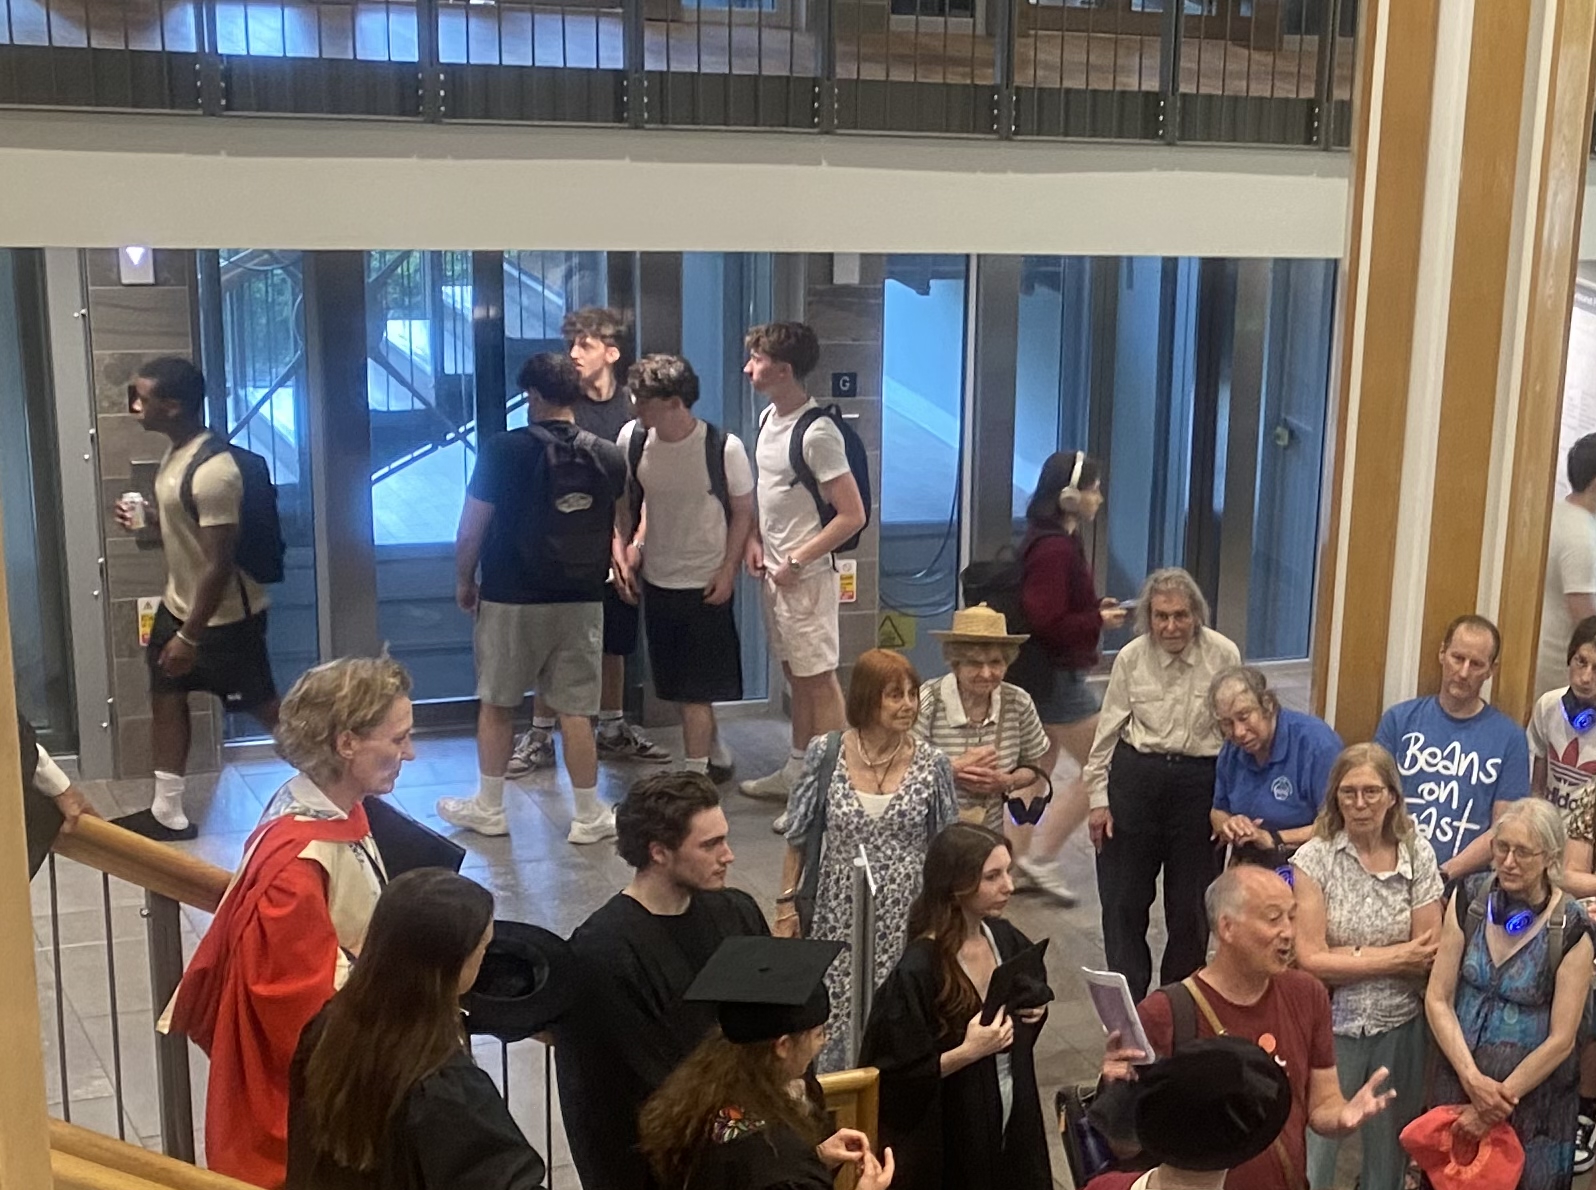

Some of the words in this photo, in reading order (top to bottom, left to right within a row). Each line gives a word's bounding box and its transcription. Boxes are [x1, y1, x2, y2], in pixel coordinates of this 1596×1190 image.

[839, 375, 850, 391] G
[1397, 731, 1502, 785] Beans
[1417, 780, 1459, 810] on
[1403, 797, 1481, 858] ast
